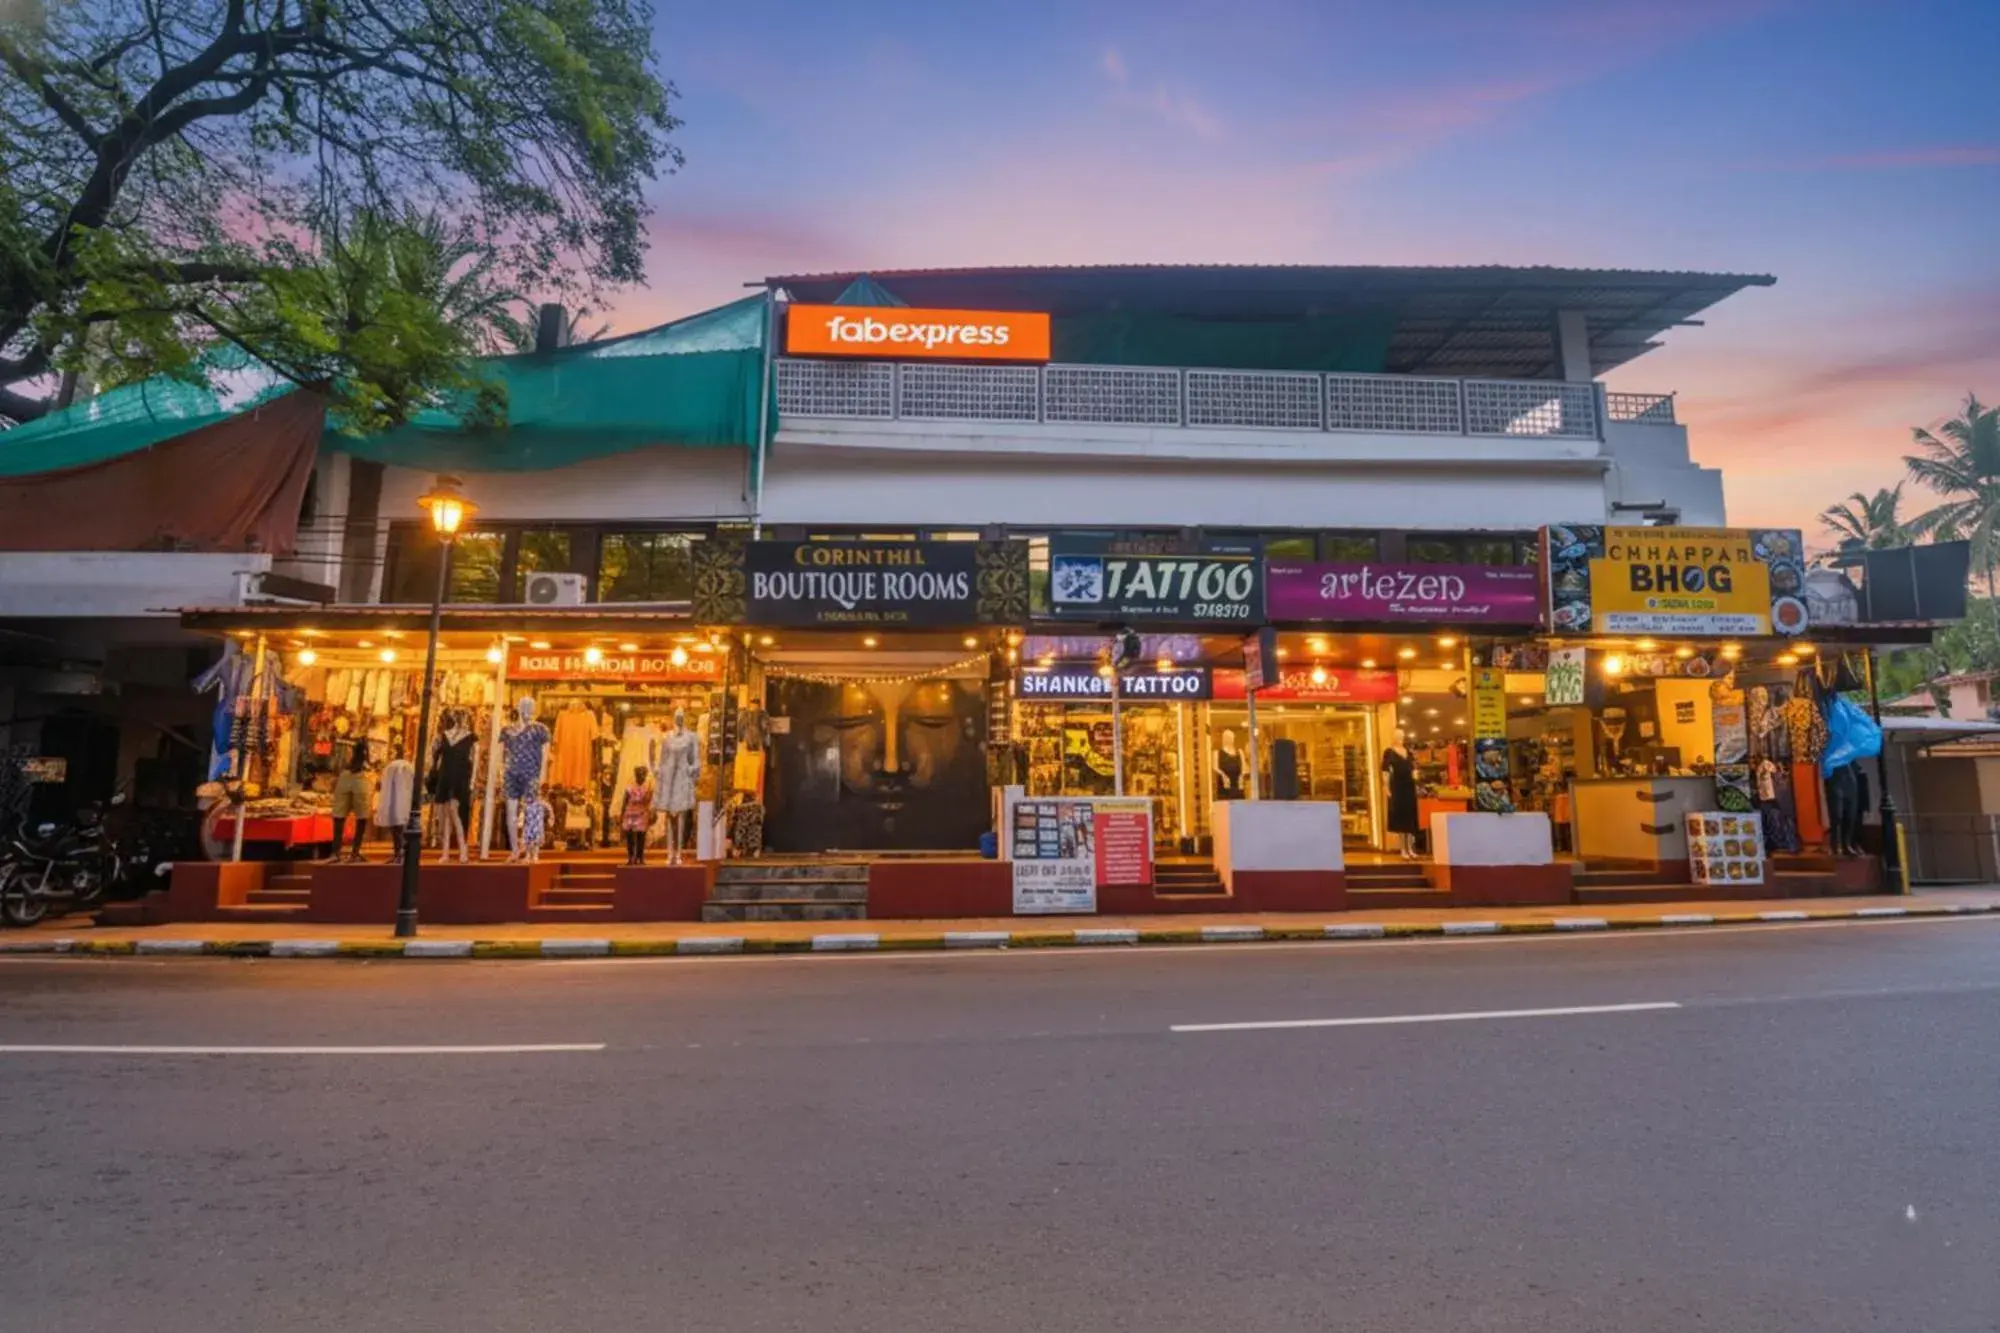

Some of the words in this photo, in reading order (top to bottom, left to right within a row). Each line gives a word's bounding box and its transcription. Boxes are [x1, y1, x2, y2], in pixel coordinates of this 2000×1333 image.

[826, 316, 1009, 349] fabexpress
[752, 571, 877, 610] BOUTIQUE
[882, 571, 969, 600] ROOMS
[1107, 561, 1254, 600] TATTOO
[1320, 565, 1465, 601] artezen
[1630, 564, 1733, 593] BHOG
[1122, 675, 1200, 694] TATTOO
